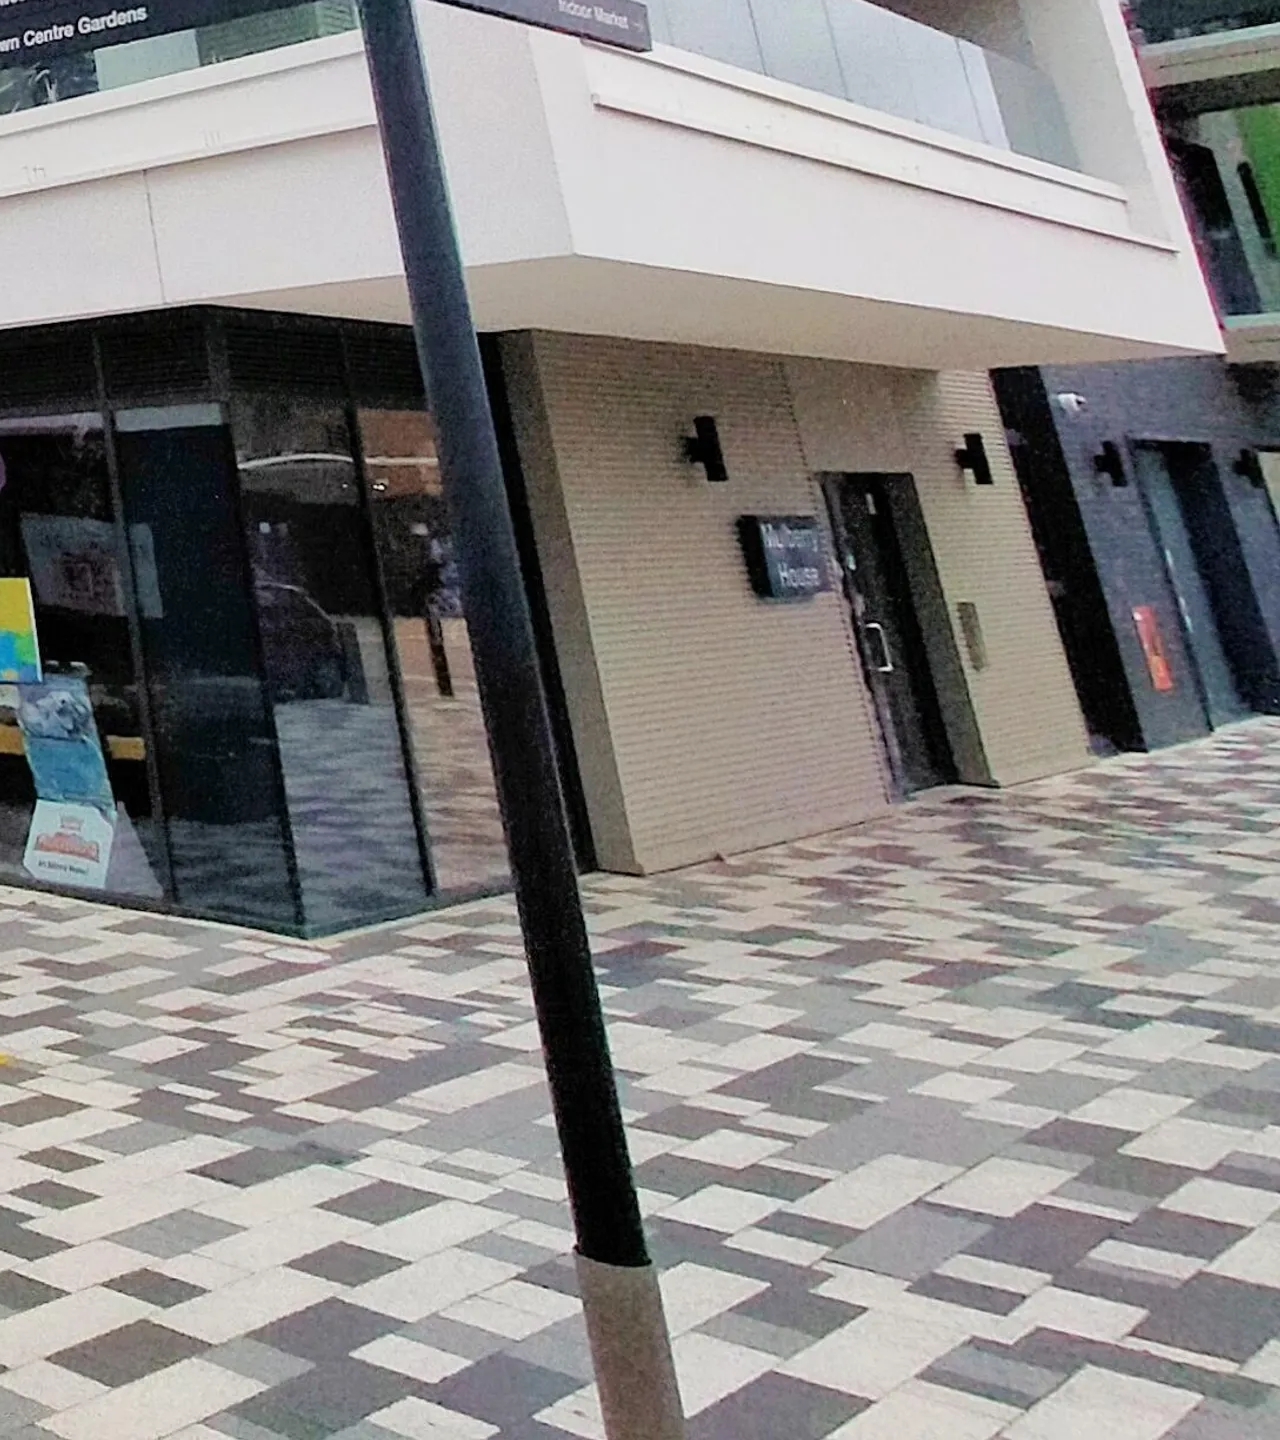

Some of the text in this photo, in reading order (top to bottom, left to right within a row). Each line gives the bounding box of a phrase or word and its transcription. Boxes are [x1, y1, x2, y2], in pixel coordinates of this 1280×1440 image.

[23, 22, 74, 47] Centre
[77, 6, 149, 34] Gardens
[779, 563, 820, 588] House
